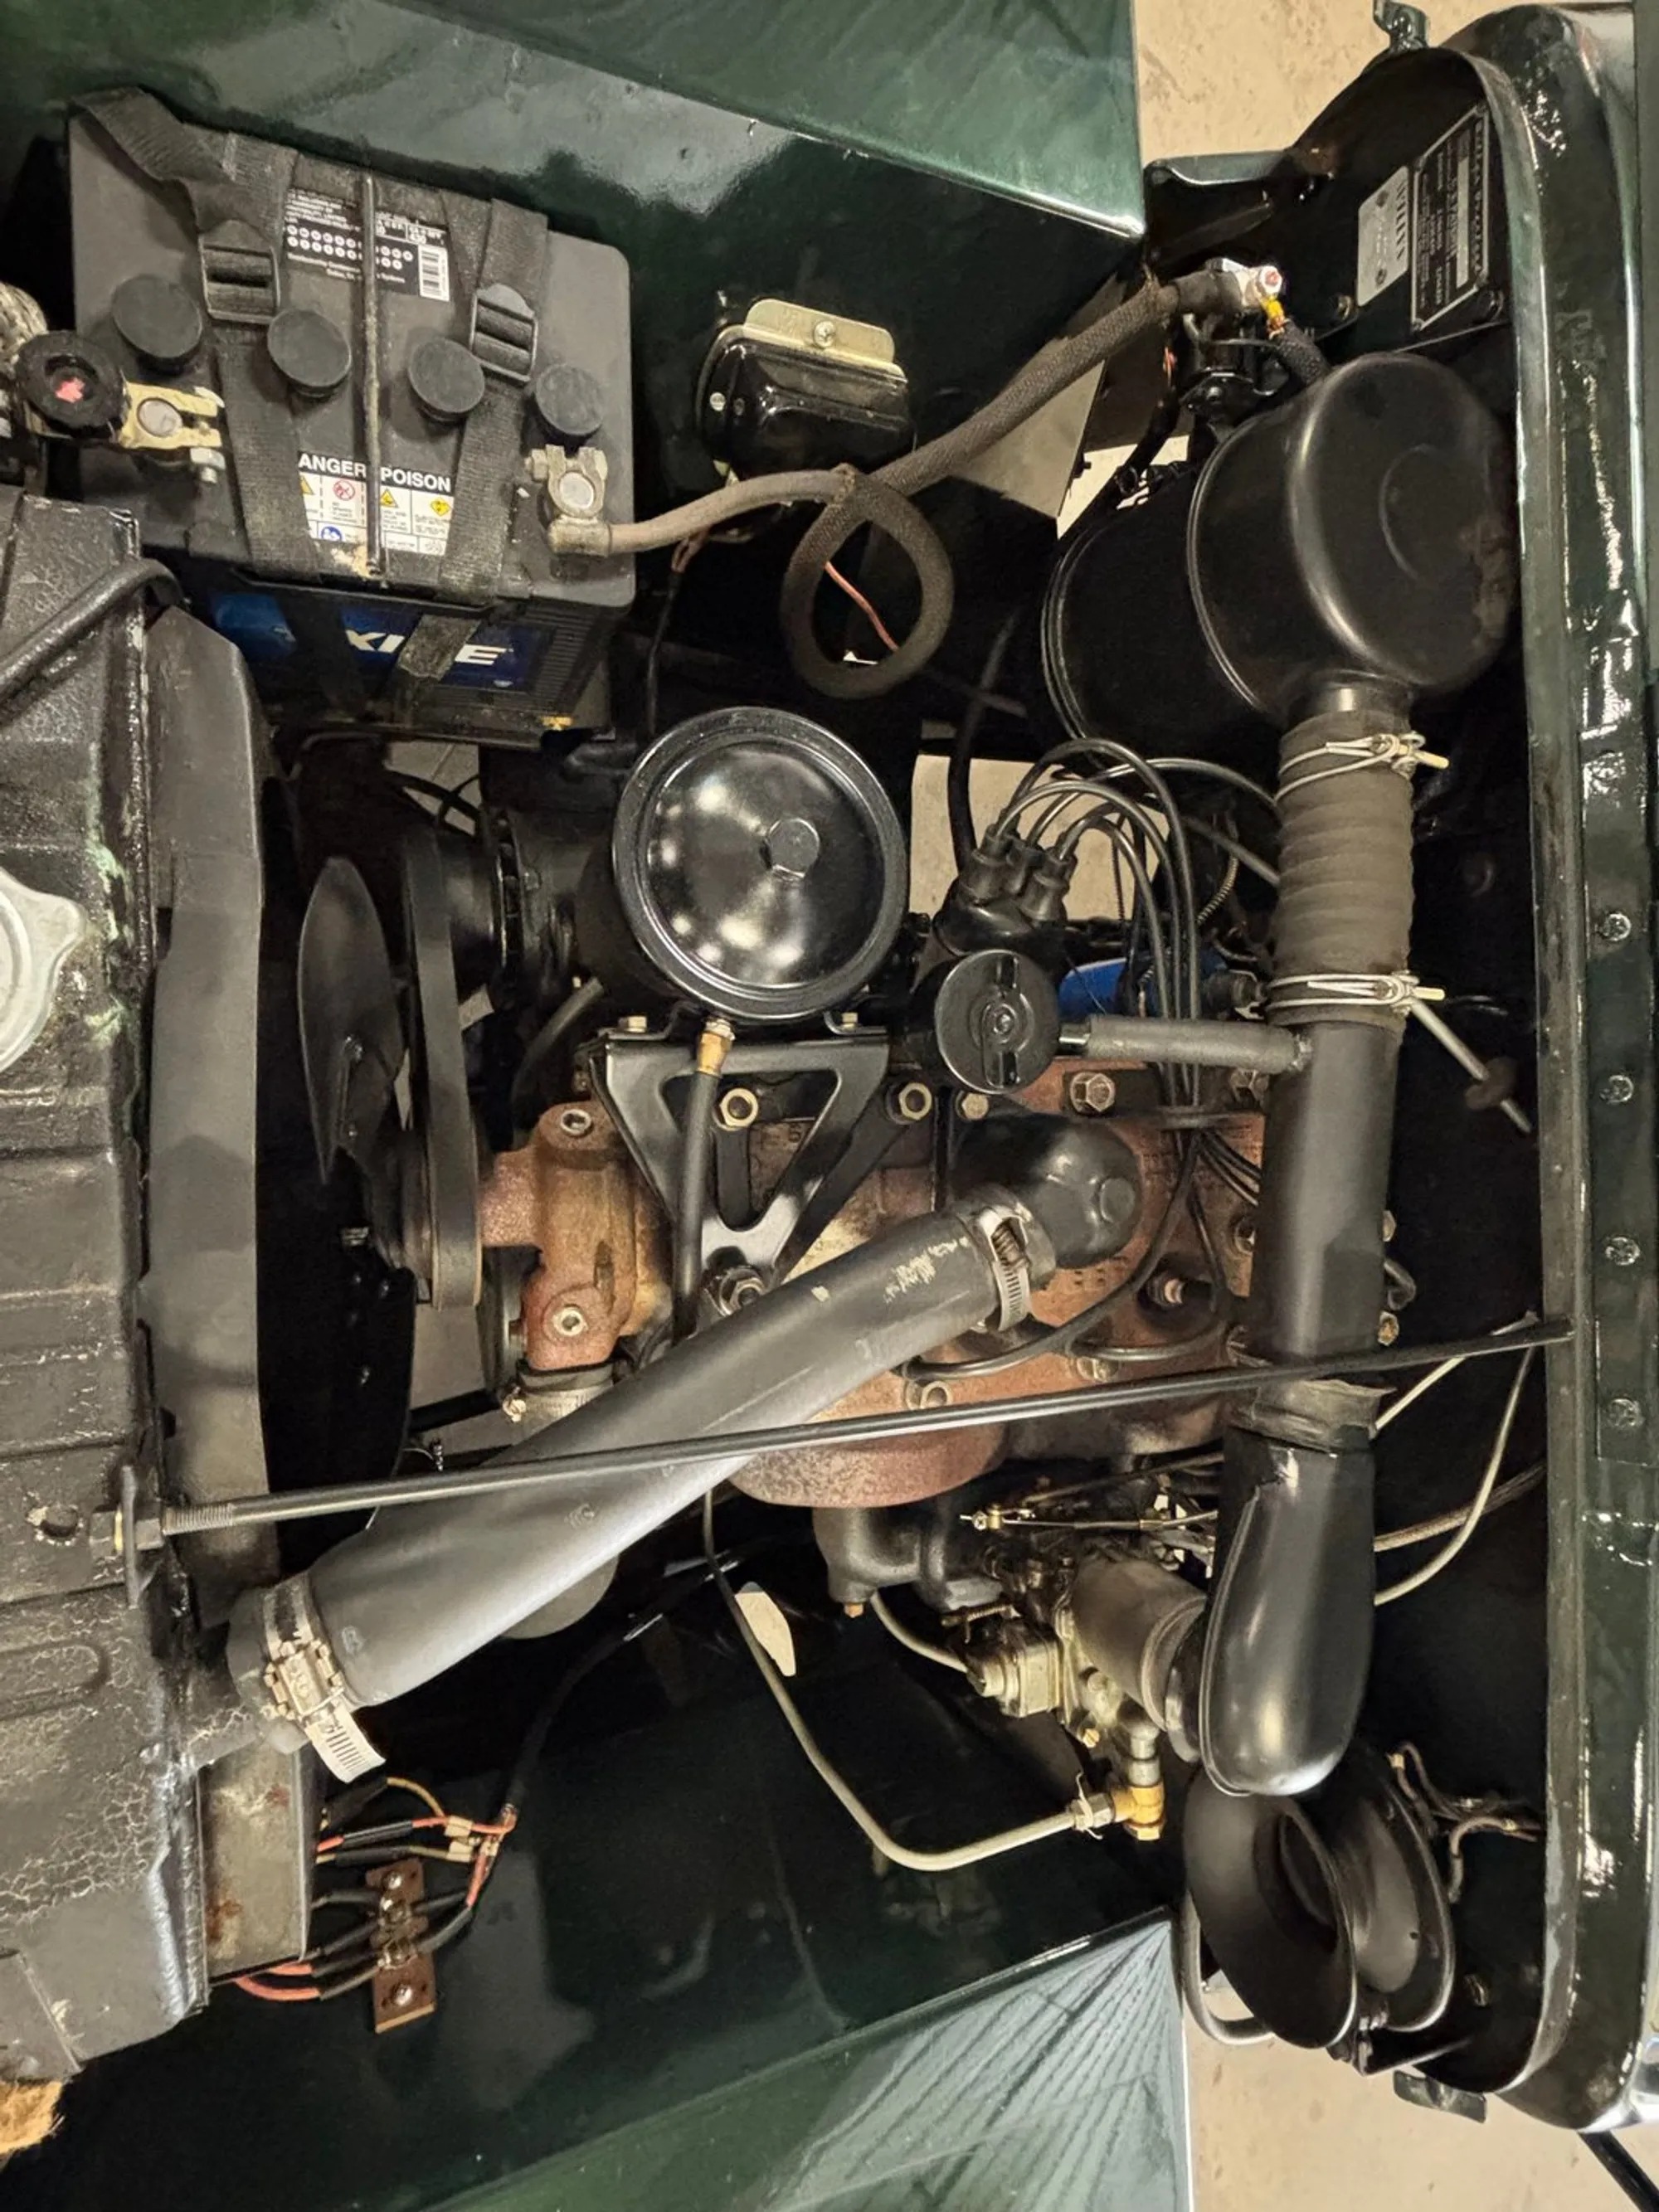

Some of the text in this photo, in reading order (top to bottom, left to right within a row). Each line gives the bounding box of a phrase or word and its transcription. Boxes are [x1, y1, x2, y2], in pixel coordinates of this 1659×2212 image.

[298, 452, 451, 493] ANGER POISON
[345, 629, 508, 666] XIE
